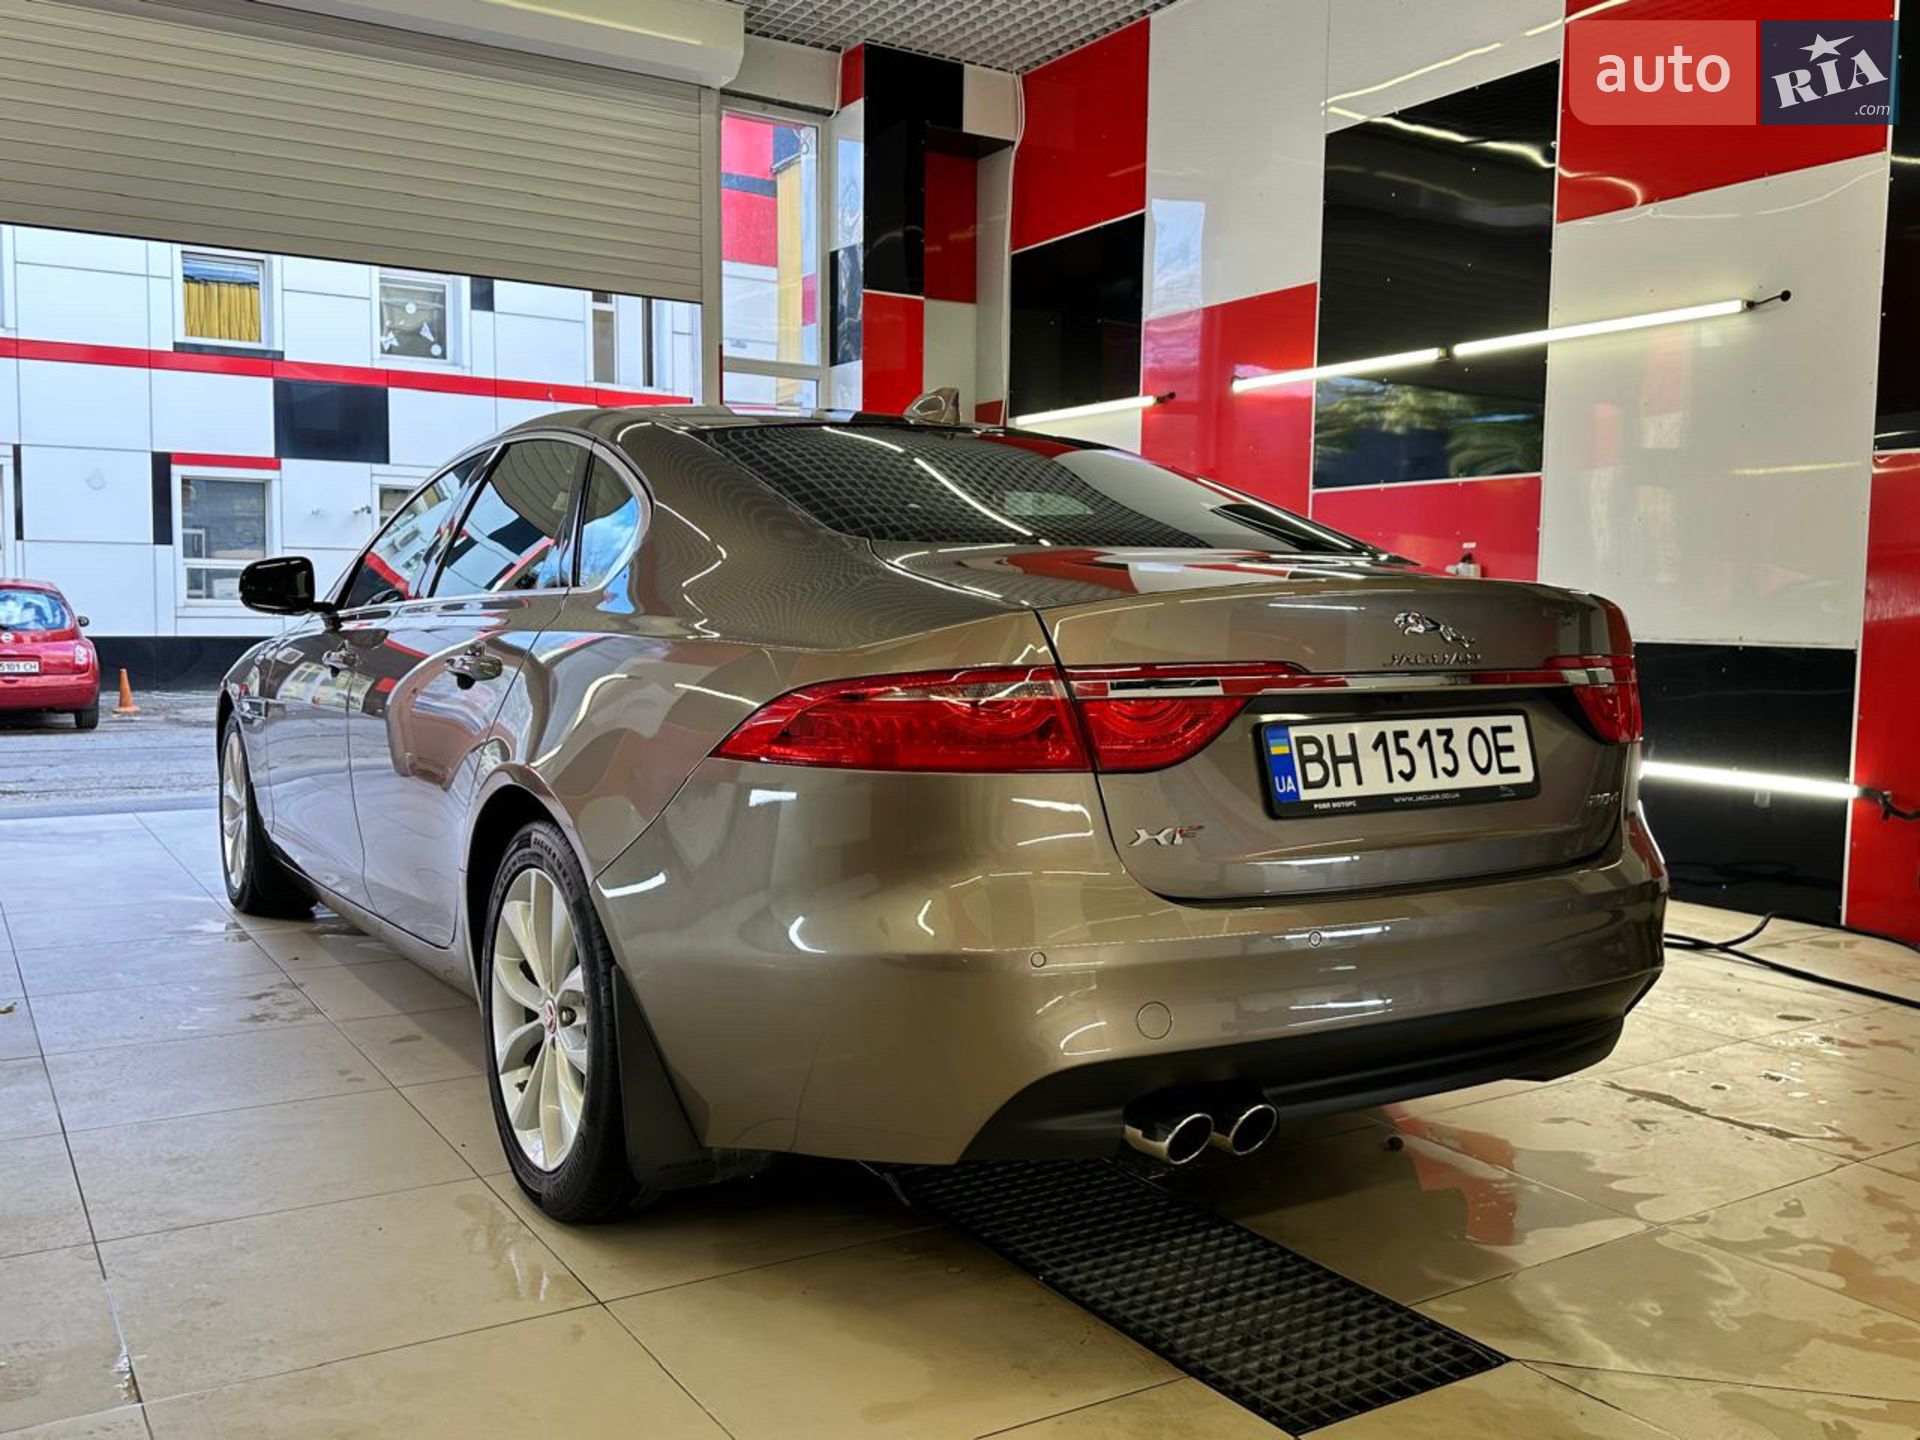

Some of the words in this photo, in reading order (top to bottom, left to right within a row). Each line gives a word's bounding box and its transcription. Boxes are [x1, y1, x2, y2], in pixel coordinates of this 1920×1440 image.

[1294, 733, 1363, 790] BH
[1371, 728, 1460, 784] 1513
[1467, 725, 1521, 776] OE
[1275, 775, 1297, 793] UA
[1128, 826, 1204, 847] XF
